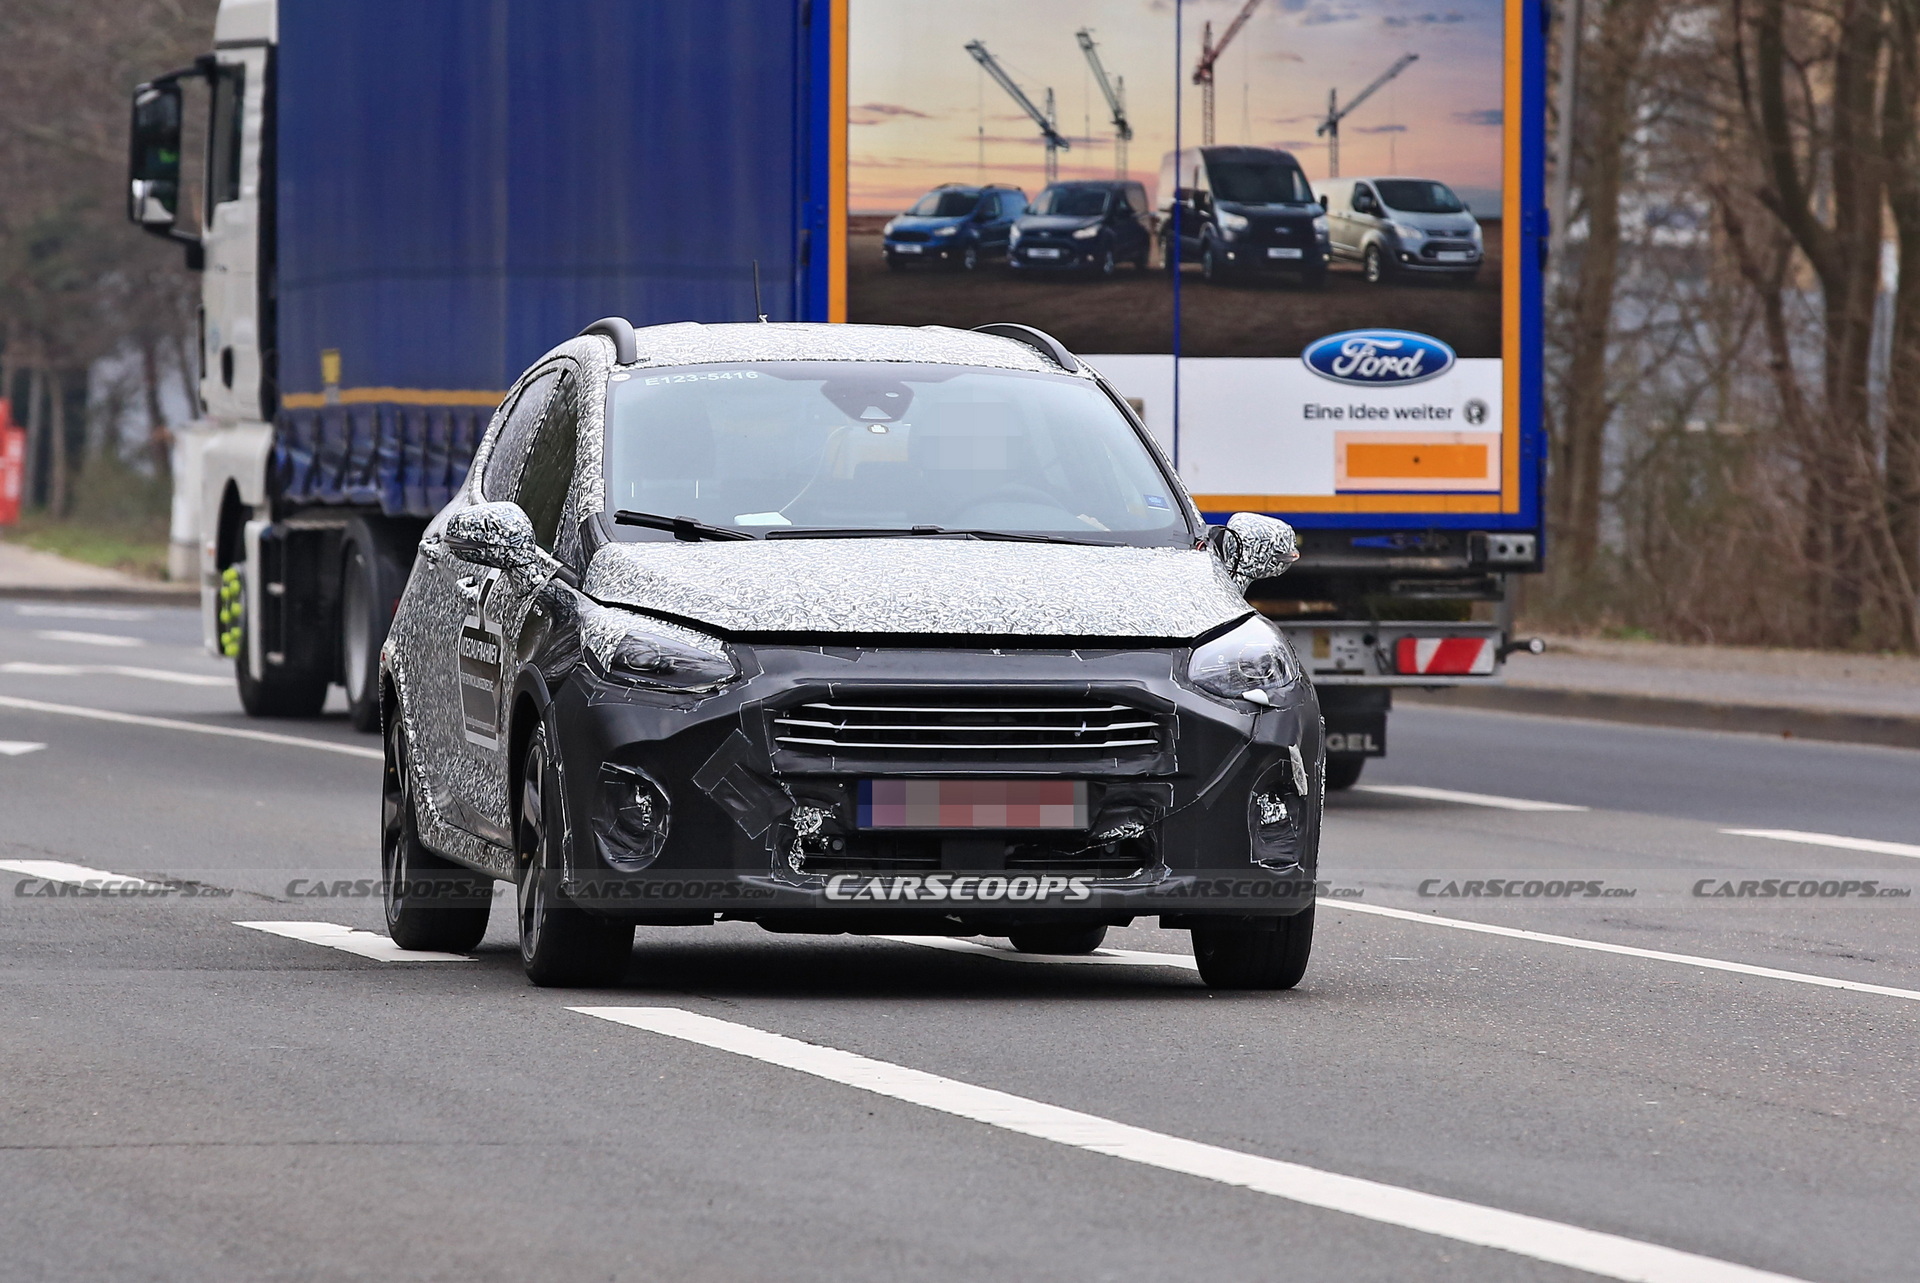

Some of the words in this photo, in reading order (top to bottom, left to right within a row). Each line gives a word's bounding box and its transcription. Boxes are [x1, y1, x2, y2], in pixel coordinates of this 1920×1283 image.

[1332, 337, 1426, 377] Ford
[645, 371, 759, 386] E123-5416
[1303, 404, 1343, 419] Eine
[1348, 404, 1391, 419] Idee
[1393, 404, 1454, 419] weiter
[1325, 733, 1379, 751] GEL
